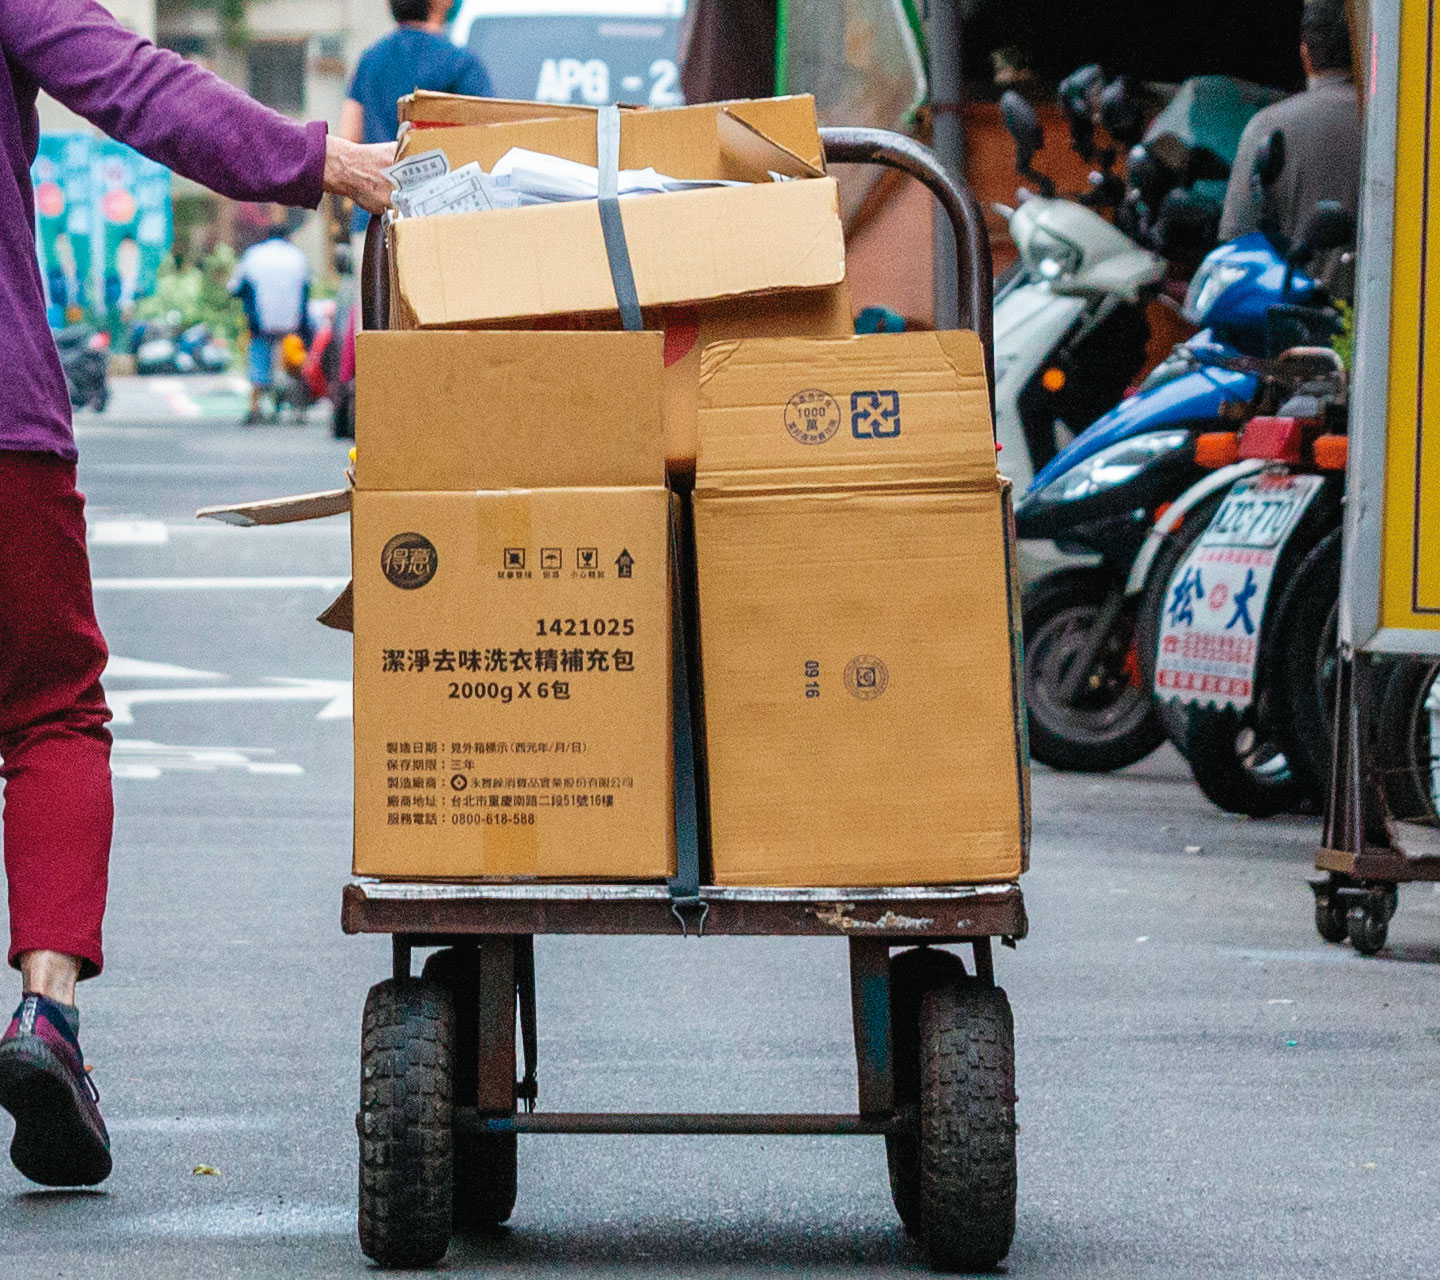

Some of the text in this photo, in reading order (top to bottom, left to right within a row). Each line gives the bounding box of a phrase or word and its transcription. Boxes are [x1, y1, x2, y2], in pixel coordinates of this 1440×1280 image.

[535, 617, 636, 637] 1421025
[381, 647, 636, 673] 潔淨去味洗衣精補充包
[448, 681, 513, 704] 2000g
[536, 680, 571, 700] 6包
[805, 680, 820, 699] 16
